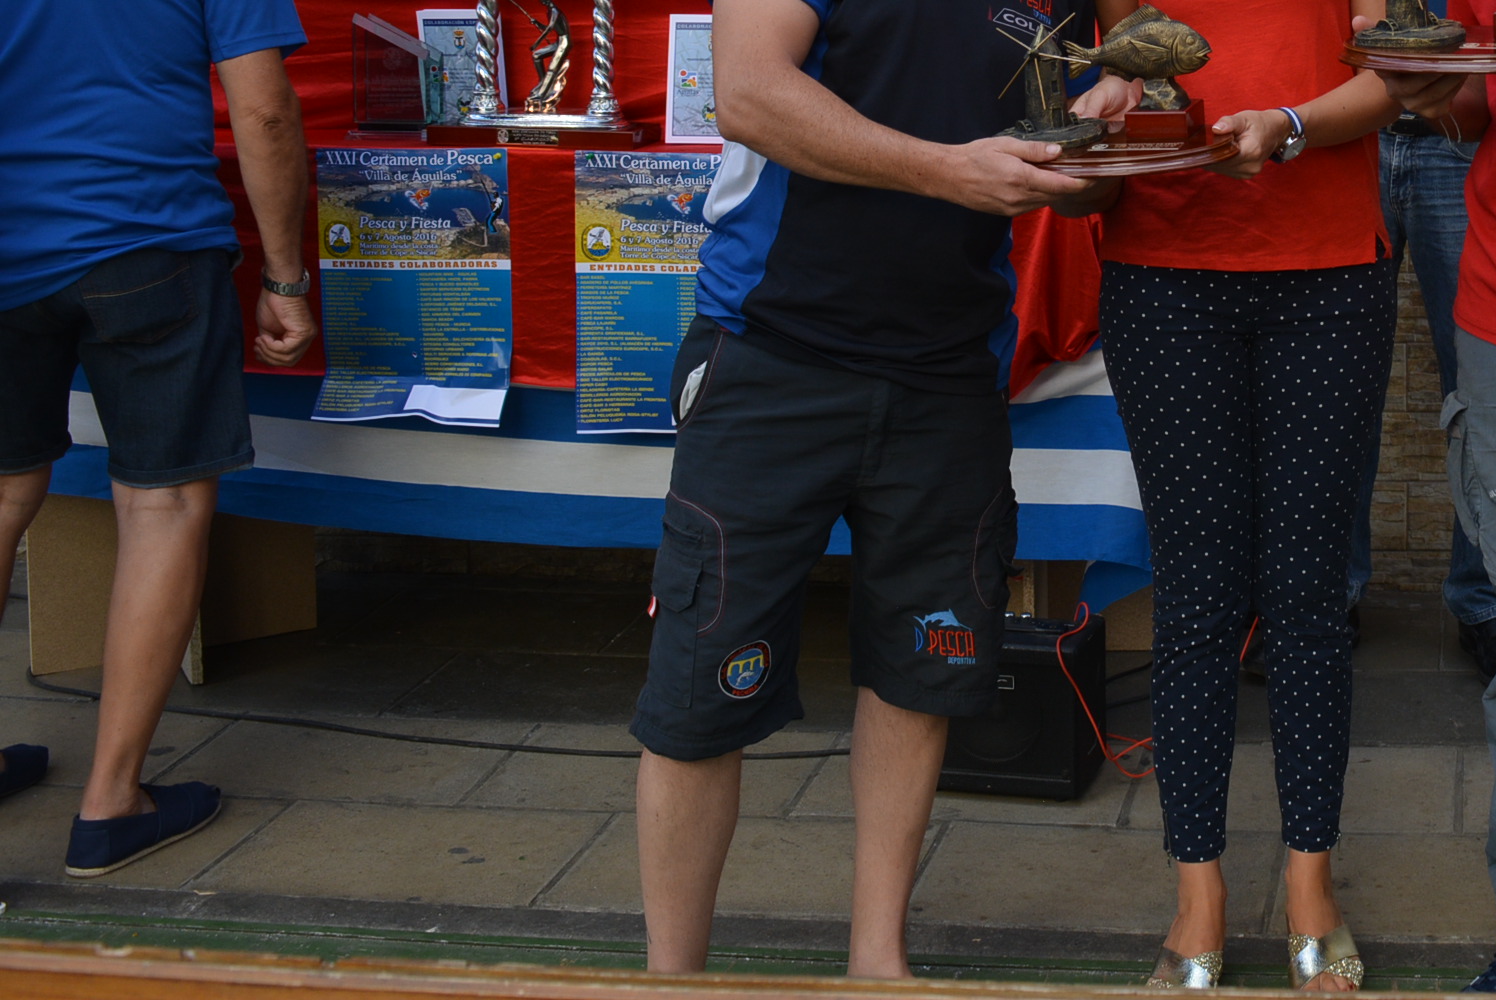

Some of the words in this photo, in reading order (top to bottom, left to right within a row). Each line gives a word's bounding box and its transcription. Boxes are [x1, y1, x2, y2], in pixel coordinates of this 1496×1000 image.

[326, 152, 356, 165] XXXI
[360, 152, 427, 166] Certamen
[430, 153, 444, 165] de
[447, 150, 493, 165] Pesca
[620, 155, 690, 170] Certamen
[693, 158, 706, 170] de
[394, 171, 409, 181] de
[656, 174, 671, 185] de
[675, 172, 713, 187] Águila
[360, 216, 396, 228] Pesca
[400, 220, 407, 231] y
[411, 216, 451, 228] Fiesta
[621, 219, 657, 232] Pesca
[661, 223, 669, 235] y
[382, 233, 411, 242] Agosto
[644, 236, 673, 245] Agosto
[927, 630, 975, 656] PESCA
